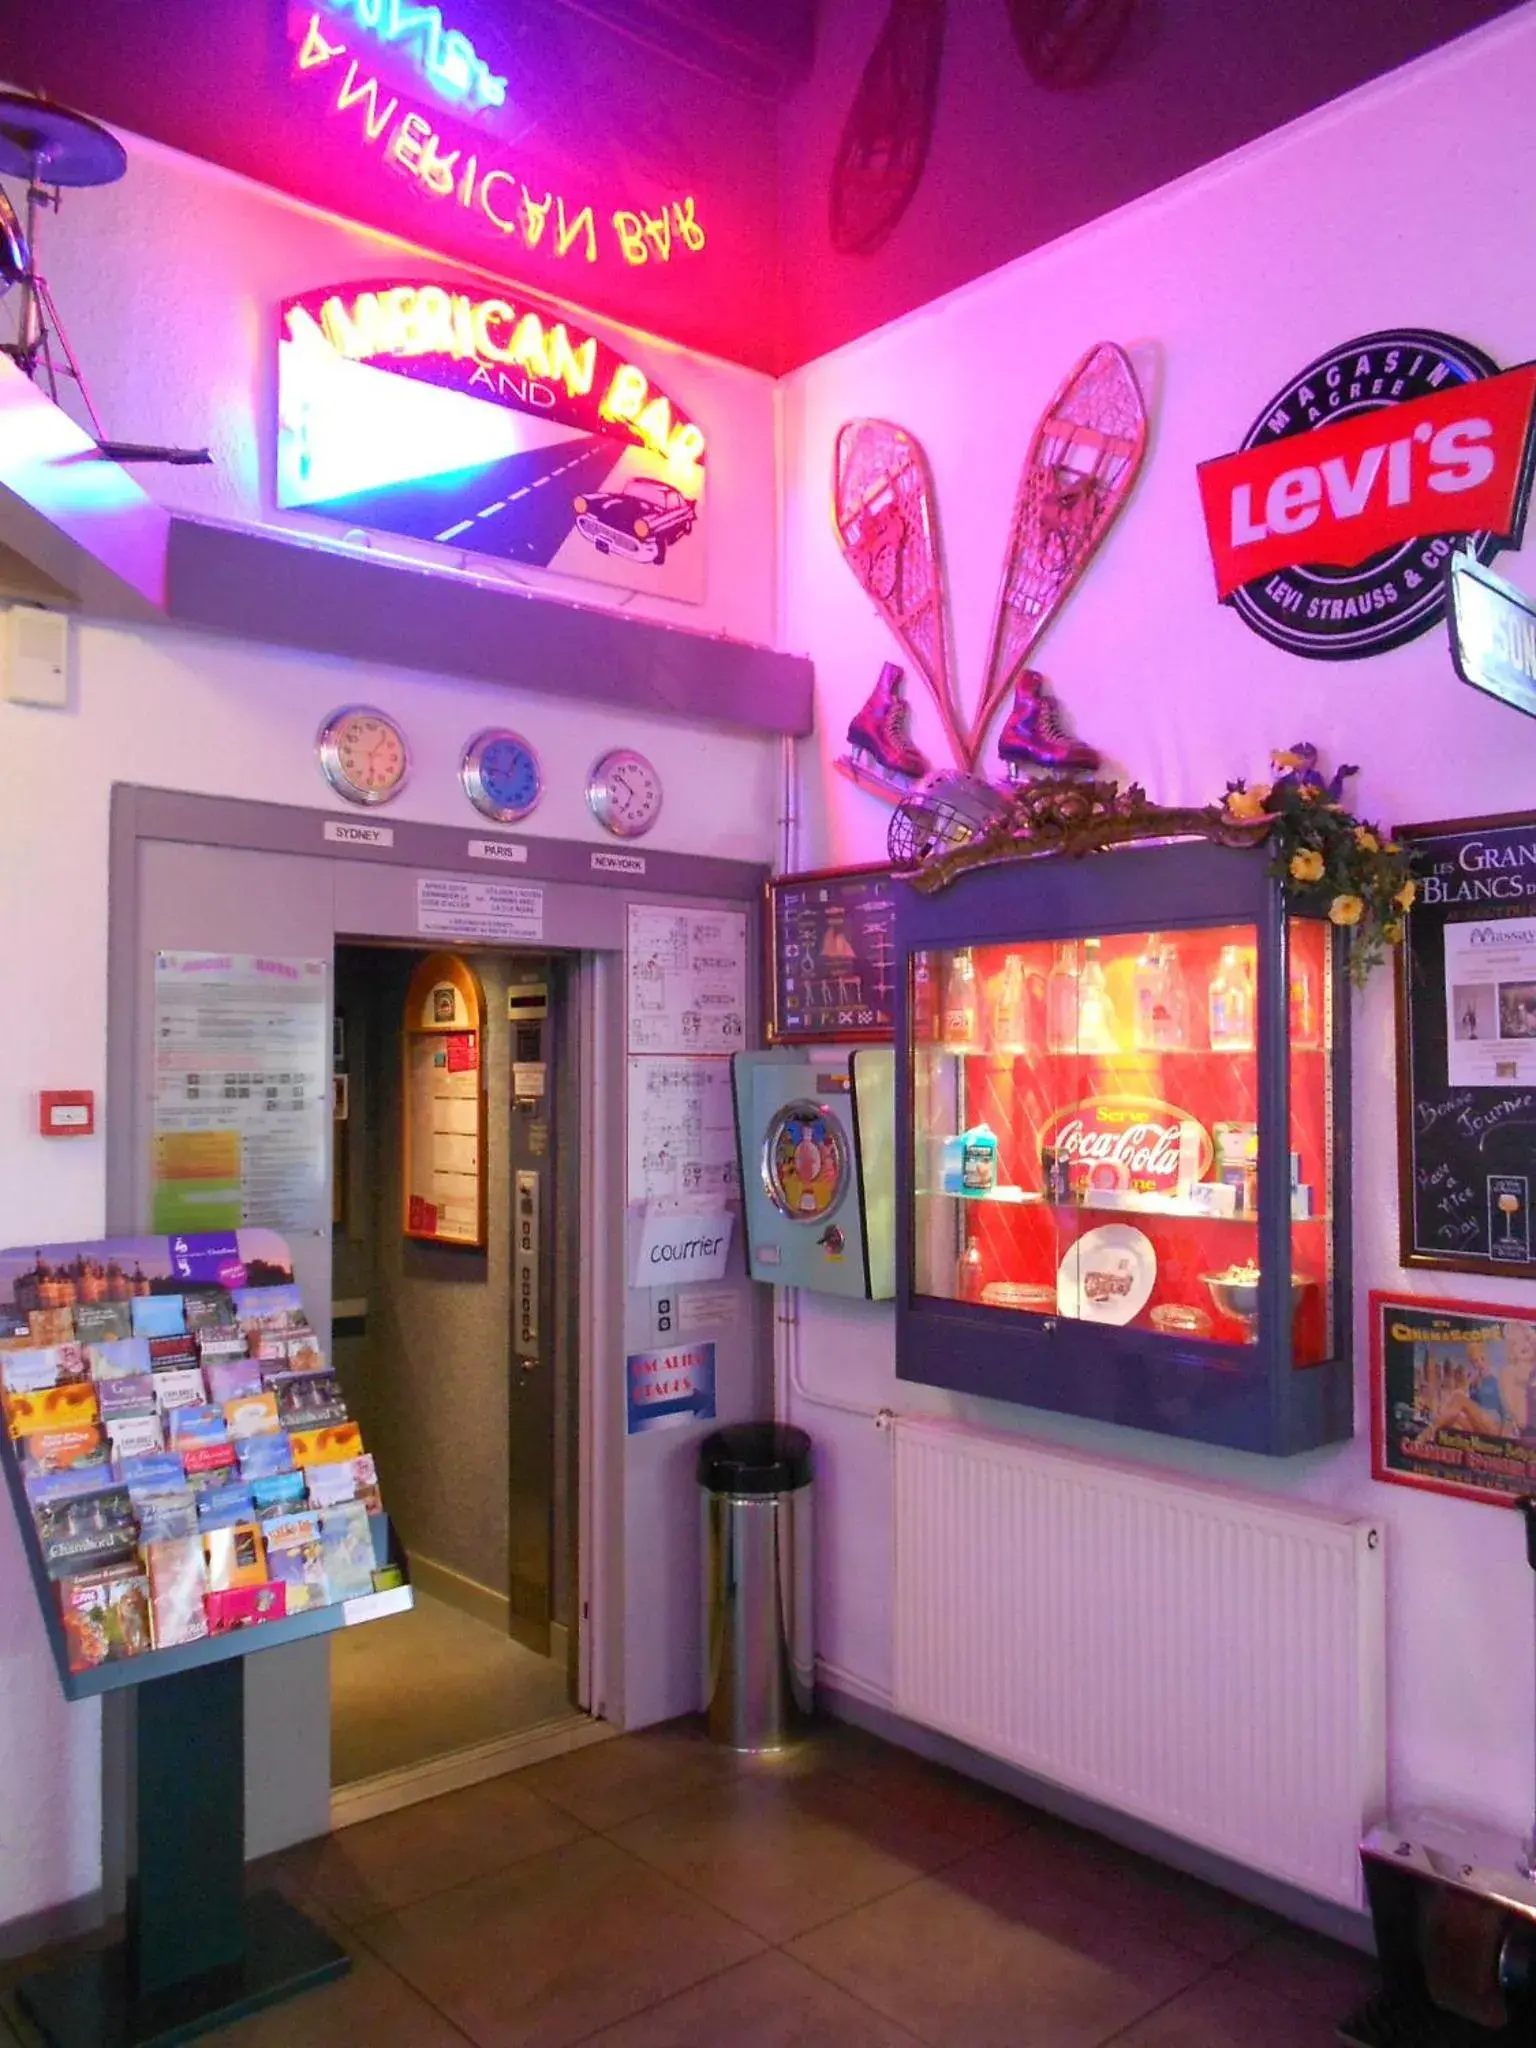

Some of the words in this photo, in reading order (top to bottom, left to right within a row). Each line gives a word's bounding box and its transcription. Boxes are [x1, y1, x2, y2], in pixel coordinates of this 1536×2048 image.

[284, 285, 598, 396] AMERICAN
[601, 364, 706, 480] BAR
[468, 365, 556, 408] AND
[1266, 350, 1451, 435] MAGASIN
[1264, 575, 1303, 613] LEVI
[1307, 583, 1399, 620] STRAUSS
[1404, 569, 1424, 587] &
[336, 827, 381, 841] SYDNEY
[484, 845, 513, 858] PARIS
[1432, 862, 1455, 875] LES
[1421, 875, 1525, 904] BLANCS
[1096, 1107, 1150, 1122] Serve
[651, 1235, 724, 1263] courrier
